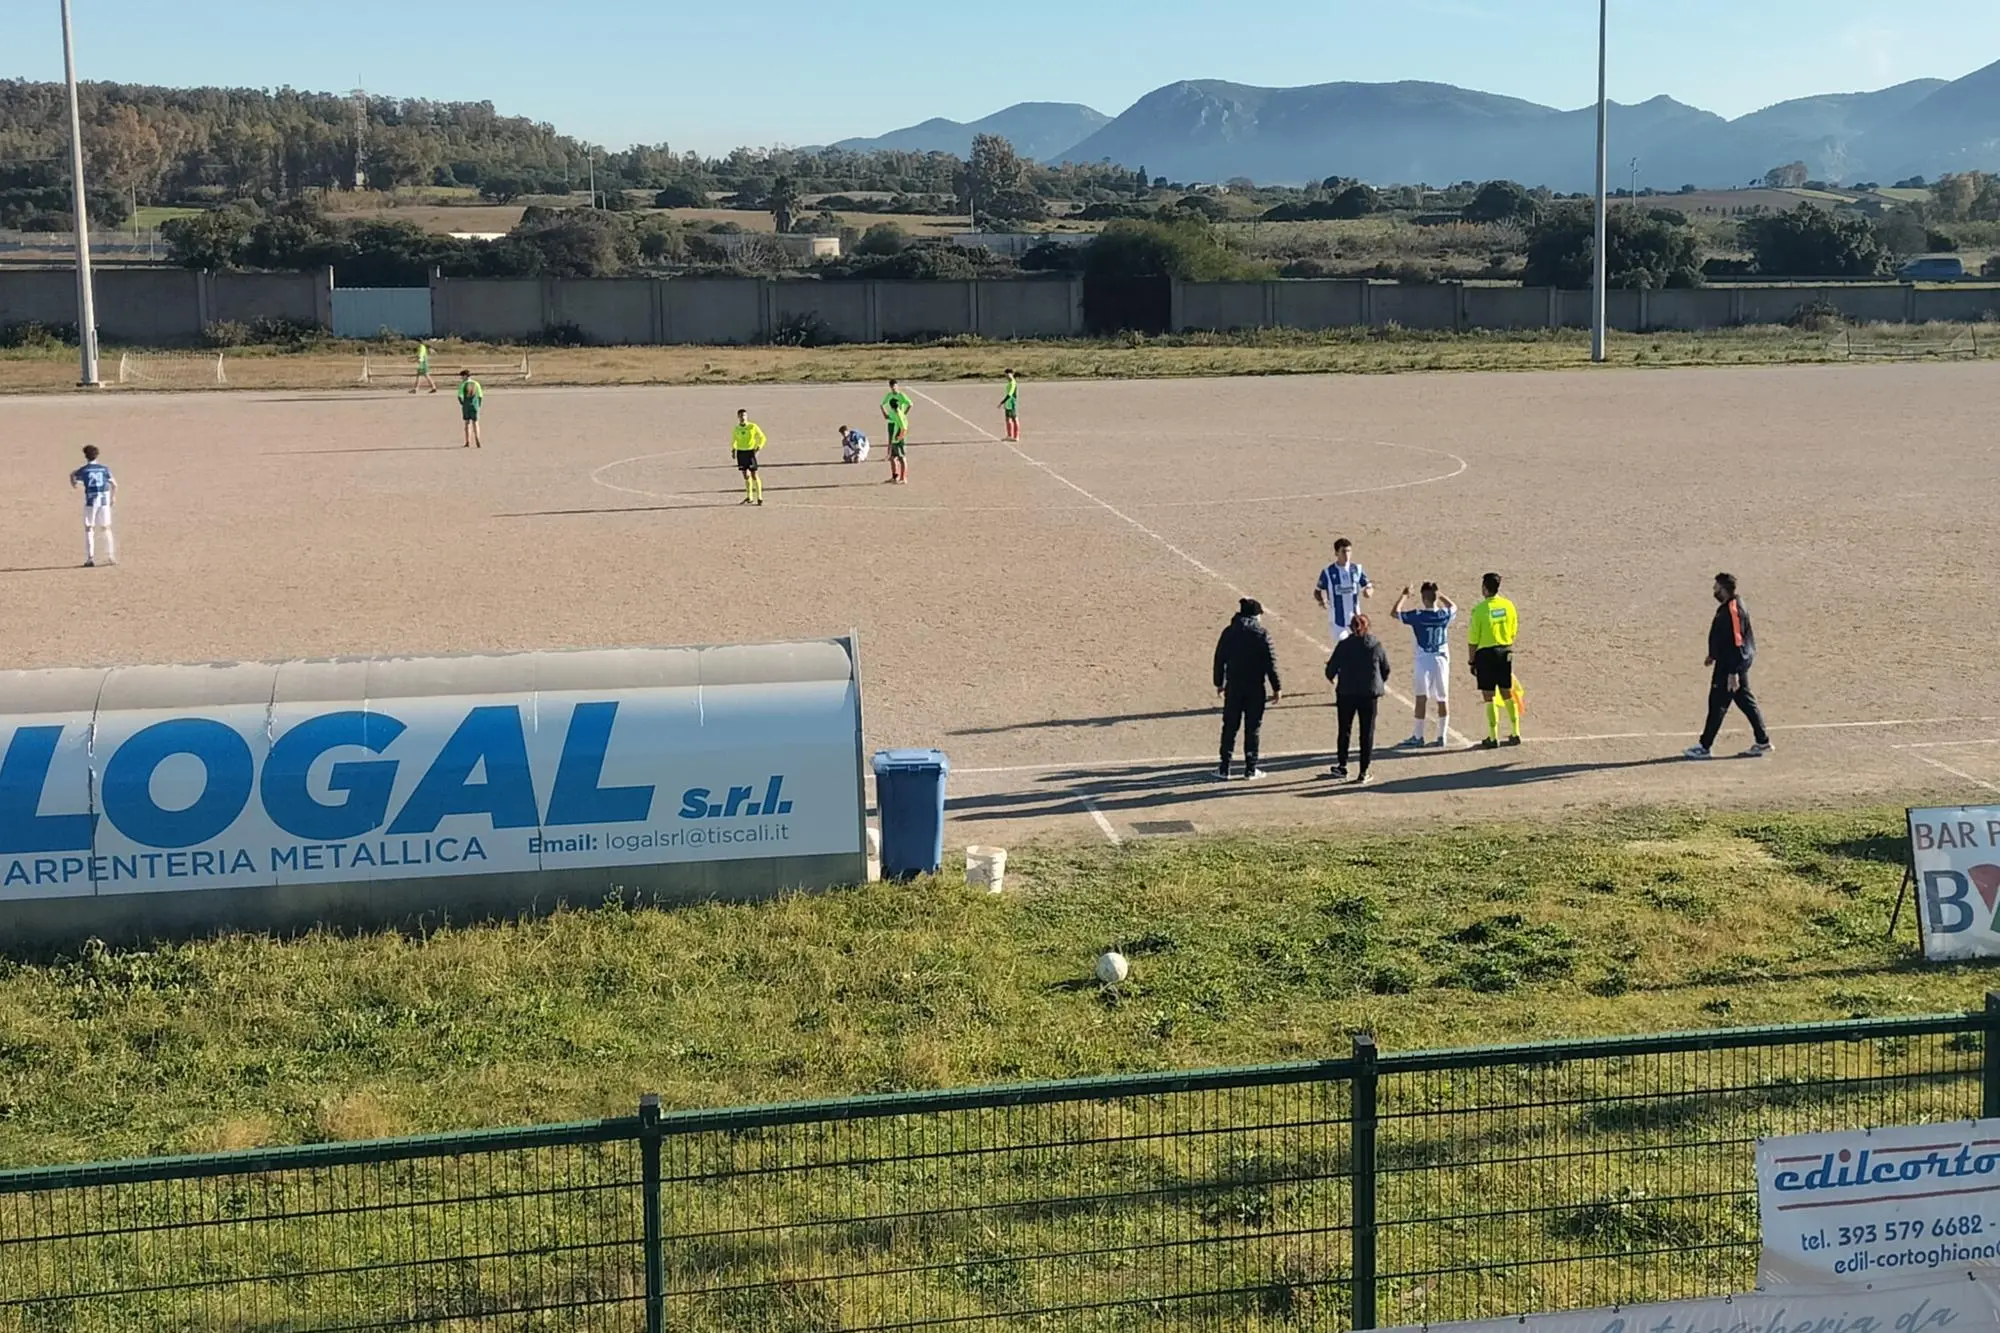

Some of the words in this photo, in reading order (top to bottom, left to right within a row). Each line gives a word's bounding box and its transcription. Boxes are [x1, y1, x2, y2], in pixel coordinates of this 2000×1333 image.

[0, 701, 655, 855] LOGAL
[678, 775, 793, 819] s.r.l.
[528, 833, 597, 853] Email:
[605, 823, 789, 851] logalsrl@tiscali.it
[1915, 821, 1978, 850] BAR
[271, 836, 487, 871] METALLICA
[1801, 1229, 1831, 1251] tel.
[1838, 1224, 1877, 1246] 393
[1885, 1220, 1924, 1241] 579
[1931, 1214, 1983, 1237] 6682
[1895, 1298, 1960, 1333] da
